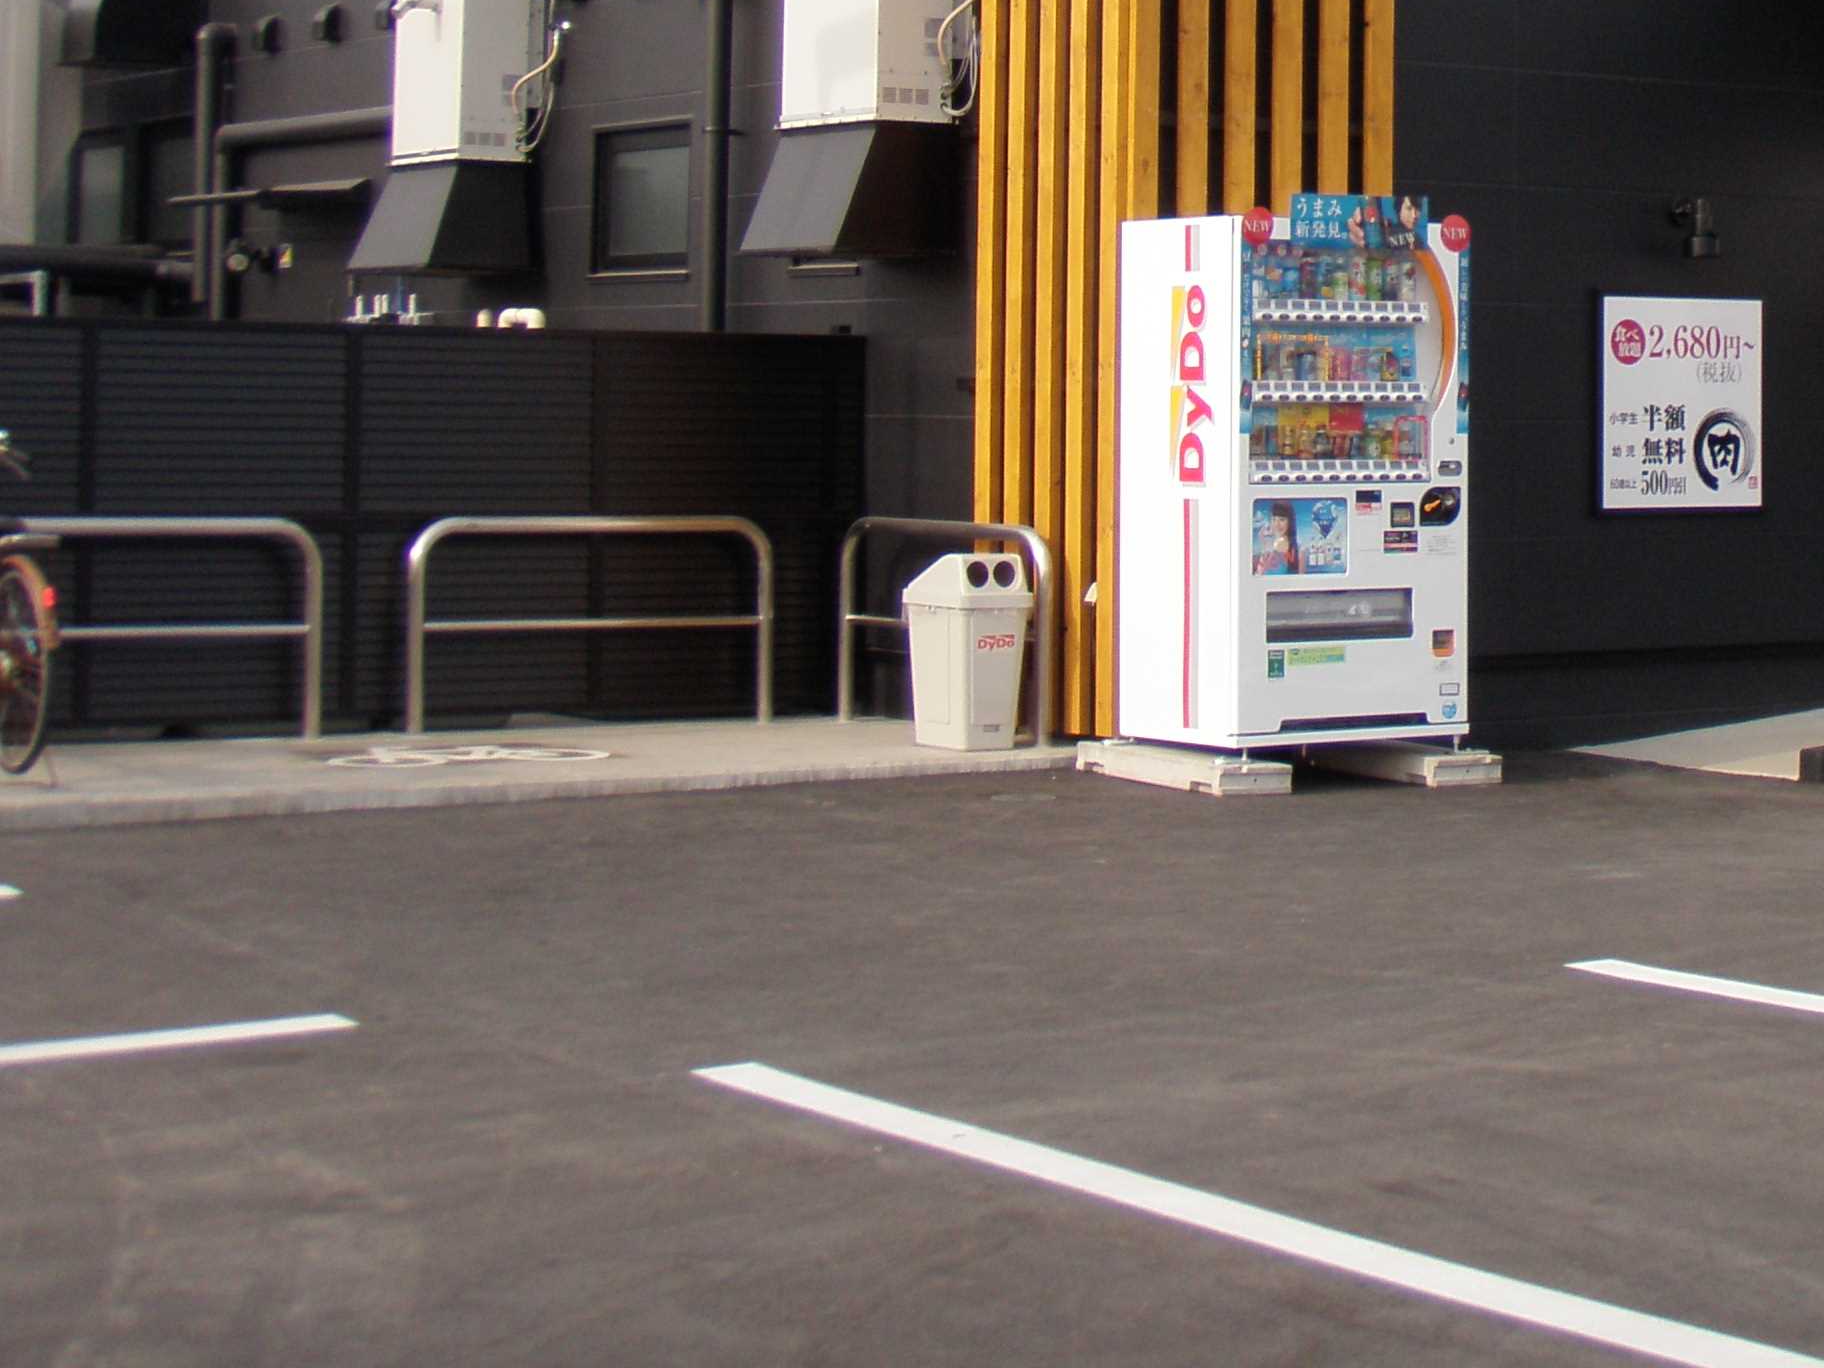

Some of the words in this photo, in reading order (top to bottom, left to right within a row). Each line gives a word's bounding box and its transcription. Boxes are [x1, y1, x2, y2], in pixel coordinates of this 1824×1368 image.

[1296, 198, 1342, 218] うまみ
[1243, 218, 1272, 233] NEW
[1295, 220, 1347, 240] 新発見。
[1442, 226, 1469, 239] NEW
[1389, 232, 1416, 247] NEW
[1614, 327, 1640, 342] 食べ
[1609, 412, 1639, 425] 小学生
[1643, 404, 1687, 432] 半額
[1641, 437, 1687, 465] 無料
[1707, 428, 1741, 477] 肉
[978, 637, 1015, 651] DyDo
